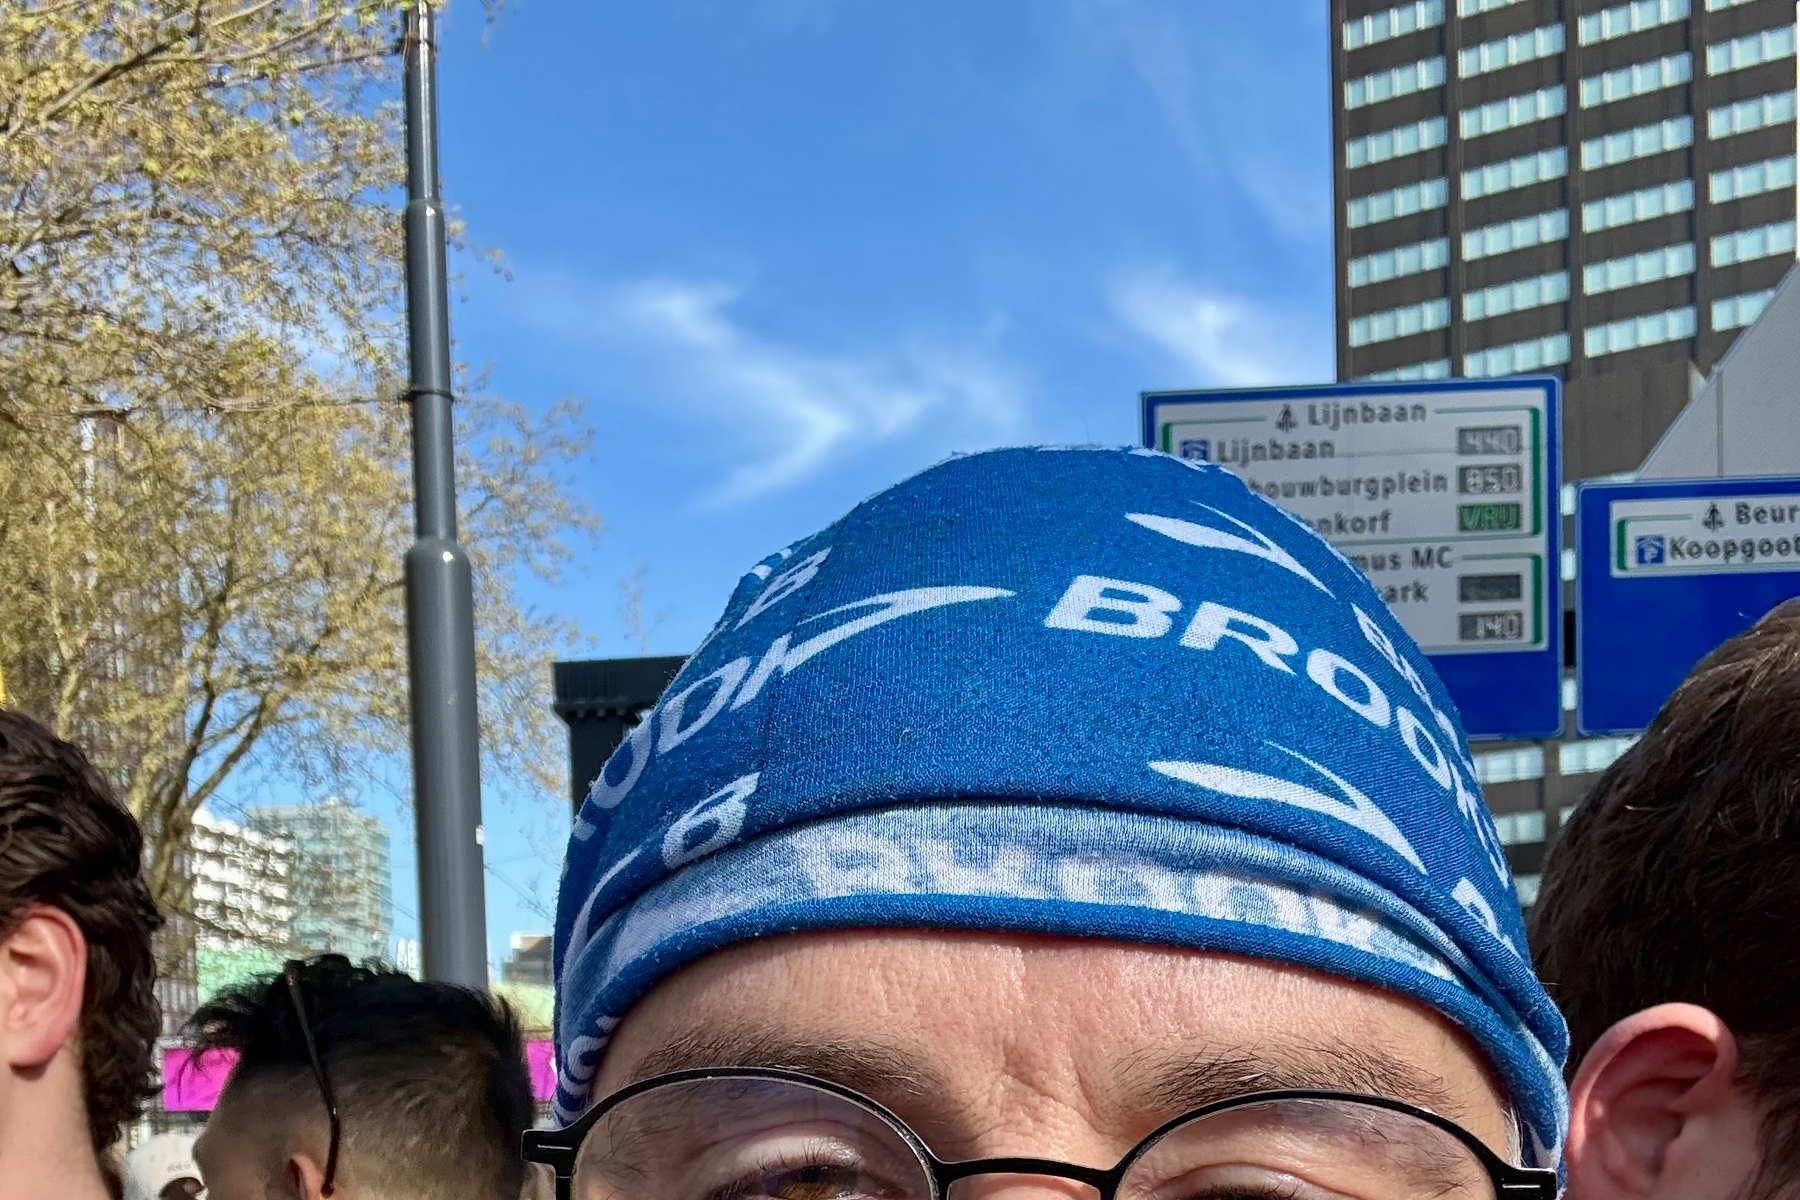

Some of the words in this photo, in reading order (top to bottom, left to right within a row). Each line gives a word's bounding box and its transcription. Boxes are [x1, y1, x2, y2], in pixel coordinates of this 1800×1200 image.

[1307, 401, 1427, 431] Lijnbaan
[1217, 437, 1336, 467] Lijnbaan
[1247, 467, 1448, 501] houwburgplein
[1465, 466, 1519, 493] 850
[1317, 509, 1391, 535] nkorf
[1734, 501, 1800, 525] Beur
[1411, 545, 1454, 569] MC
[1382, 579, 1429, 603] ark
